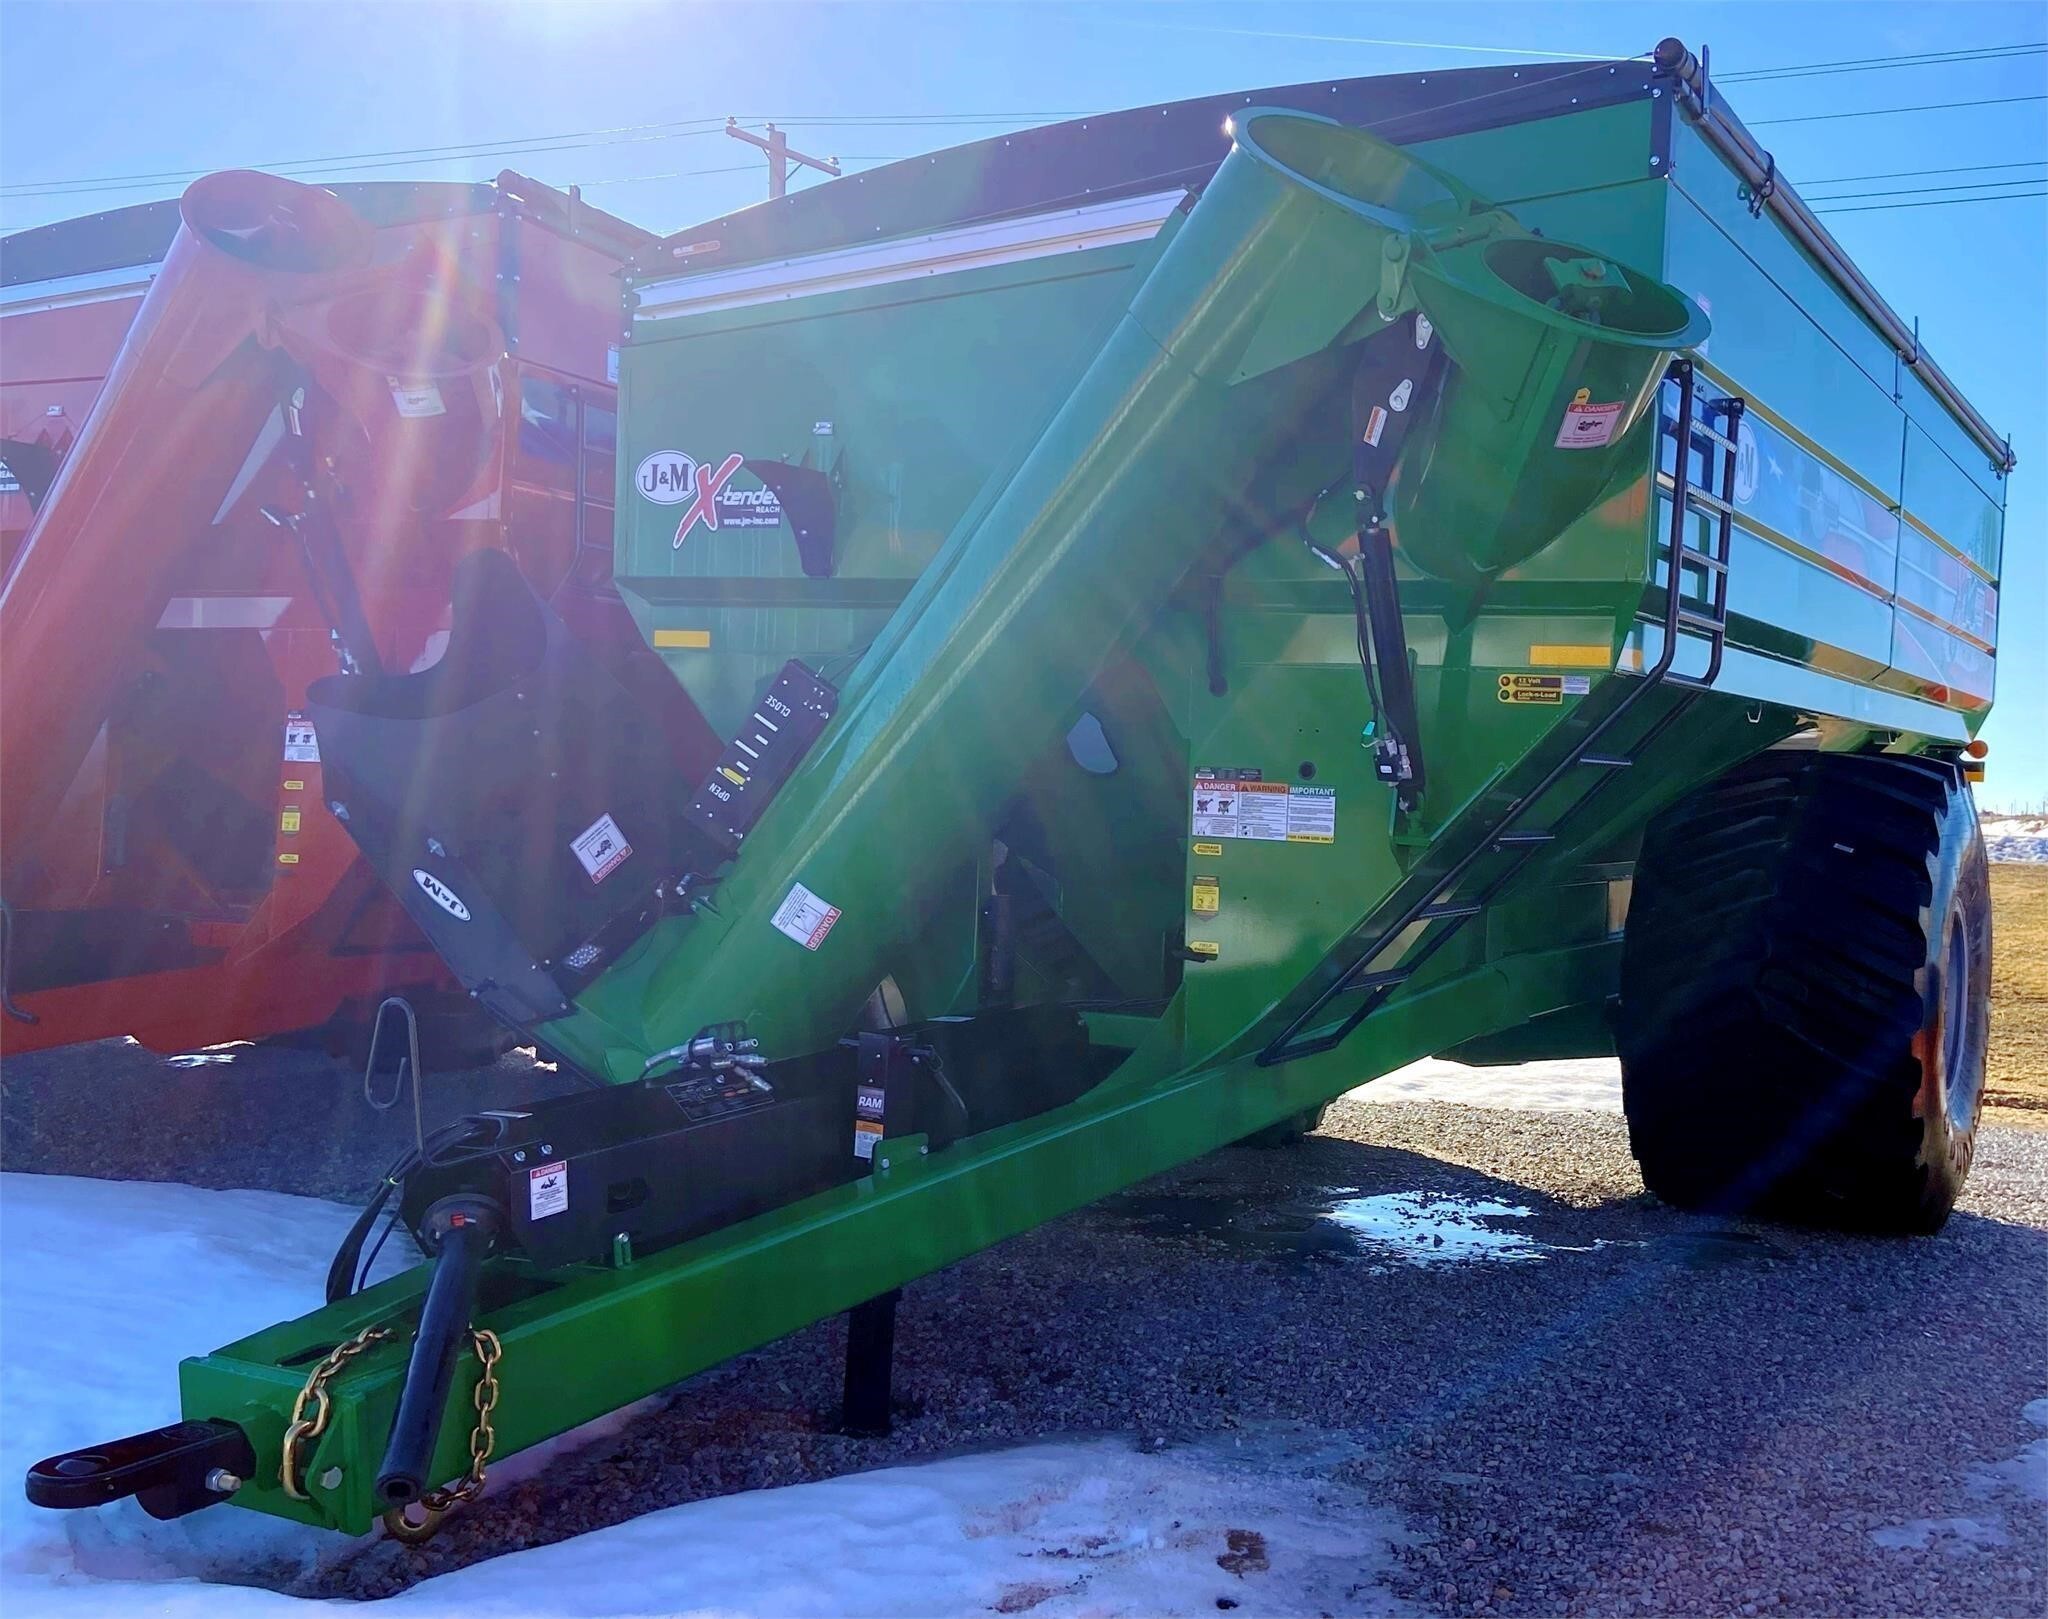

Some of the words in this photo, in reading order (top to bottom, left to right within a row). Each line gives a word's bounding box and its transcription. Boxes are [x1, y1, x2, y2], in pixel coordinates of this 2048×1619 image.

[642, 463, 690, 492] J&M
[765, 695, 791, 717] CLOSE
[708, 783, 730, 802] OPEN
[1203, 783, 1236, 791] DANGER
[1250, 785, 1286, 794] WARNING
[1290, 786, 1335, 796] IMPORTANT
[808, 916, 834, 948] DANGER
[858, 1096, 882, 1109] RAM
